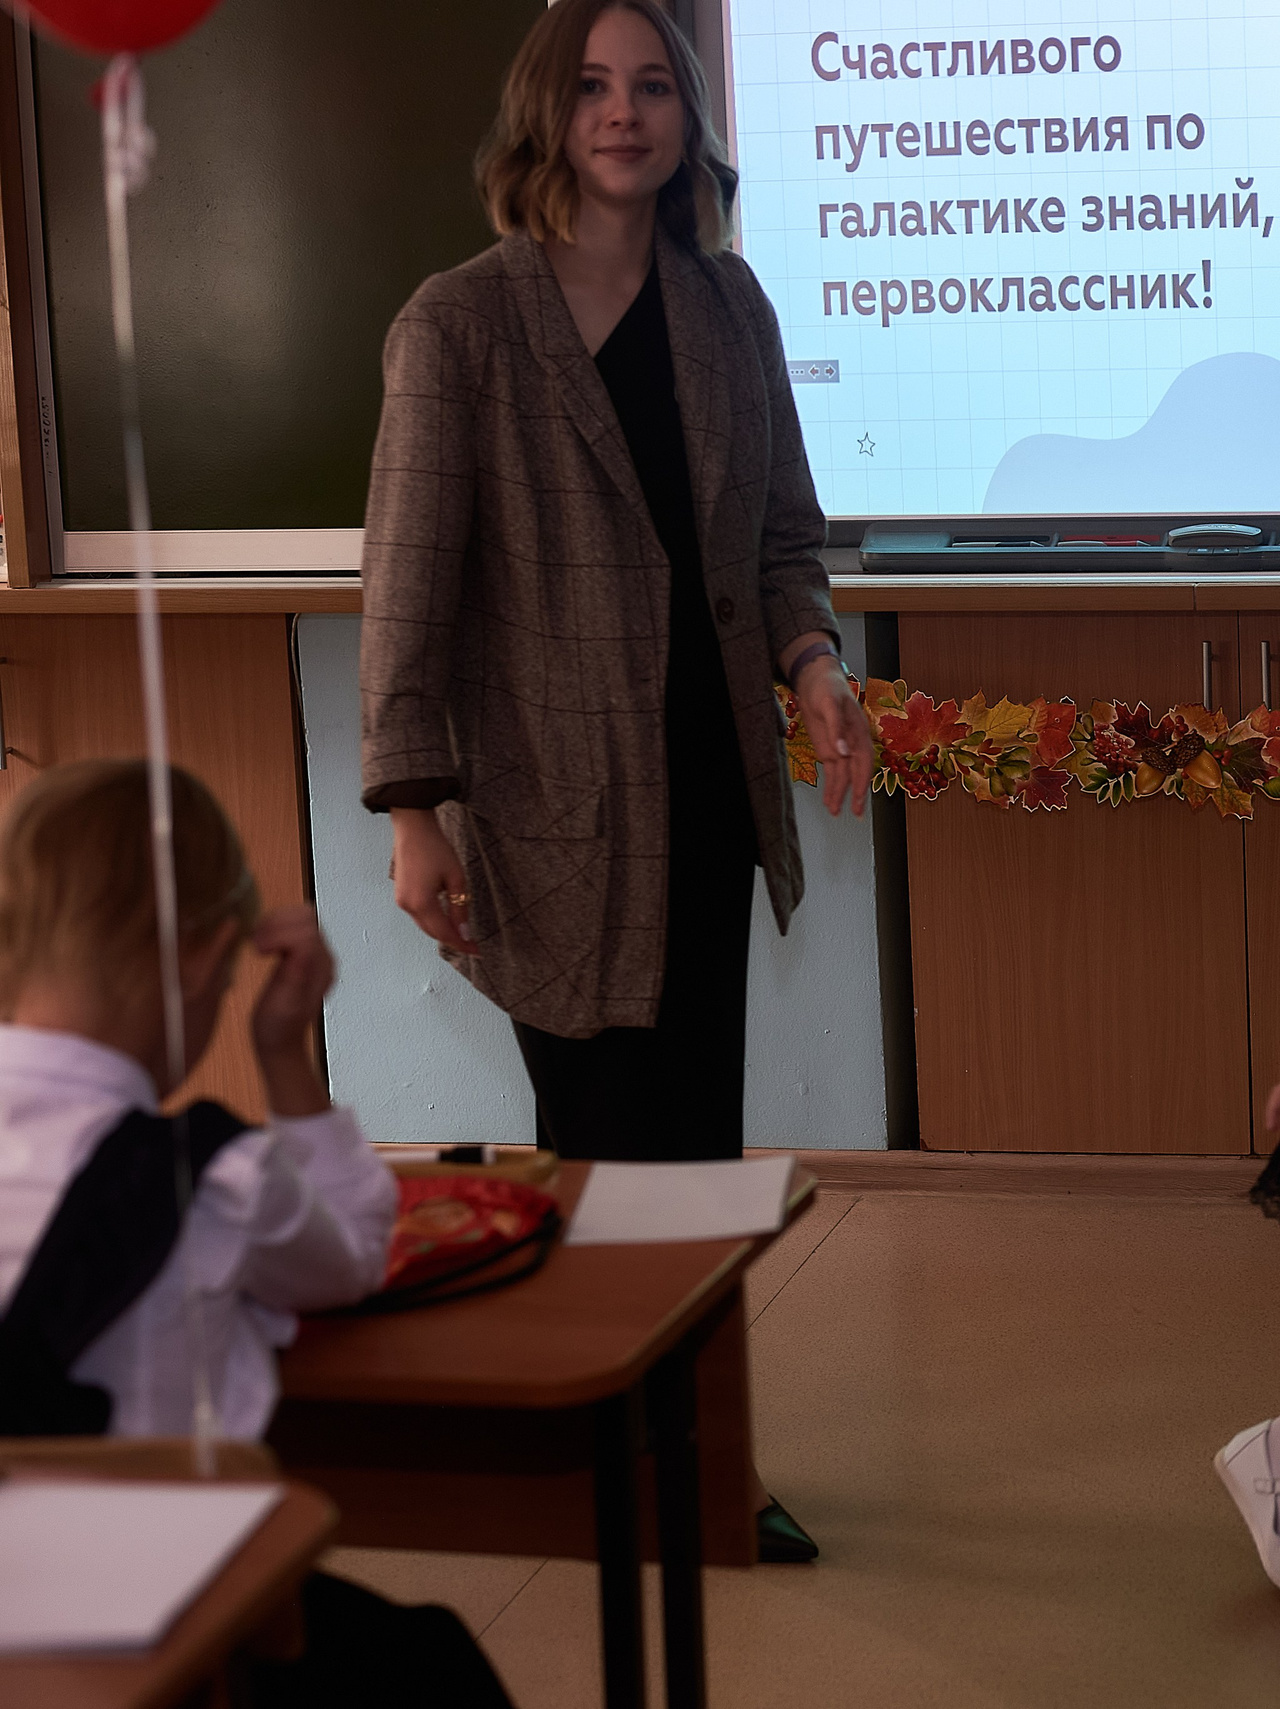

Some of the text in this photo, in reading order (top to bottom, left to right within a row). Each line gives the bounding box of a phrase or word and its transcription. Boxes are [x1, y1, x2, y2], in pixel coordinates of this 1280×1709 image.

[811, 31, 1122, 82] Счастливого
[814, 113, 1205, 173] путешествия по
[818, 177, 1274, 239] галактике знаний,
[823, 259, 1213, 328] первоклассник!
